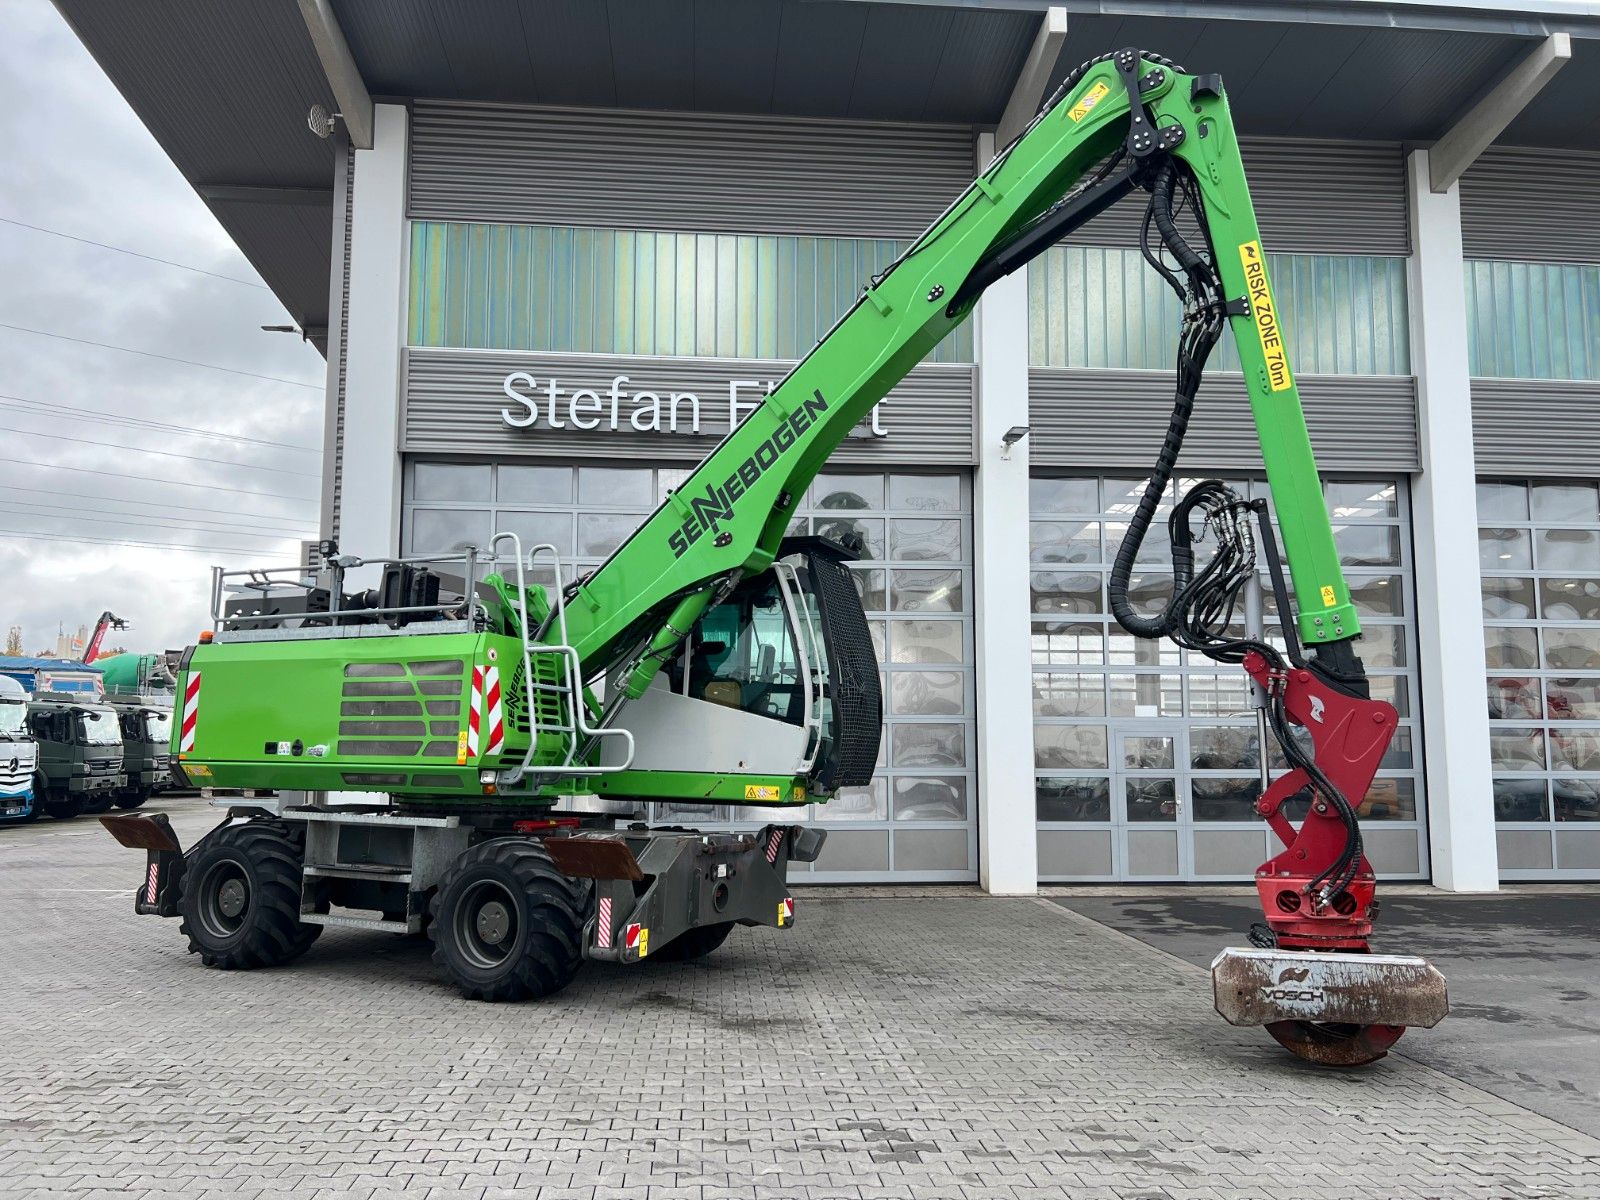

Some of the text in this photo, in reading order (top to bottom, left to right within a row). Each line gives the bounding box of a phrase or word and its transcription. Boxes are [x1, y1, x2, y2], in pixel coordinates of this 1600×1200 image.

[1246, 261, 1285, 387] RISK ZONE 70m
[501, 371, 700, 433] Stefan
[668, 388, 829, 560] SENNEBOGEN
[1260, 987, 1324, 1002] VOSCH
